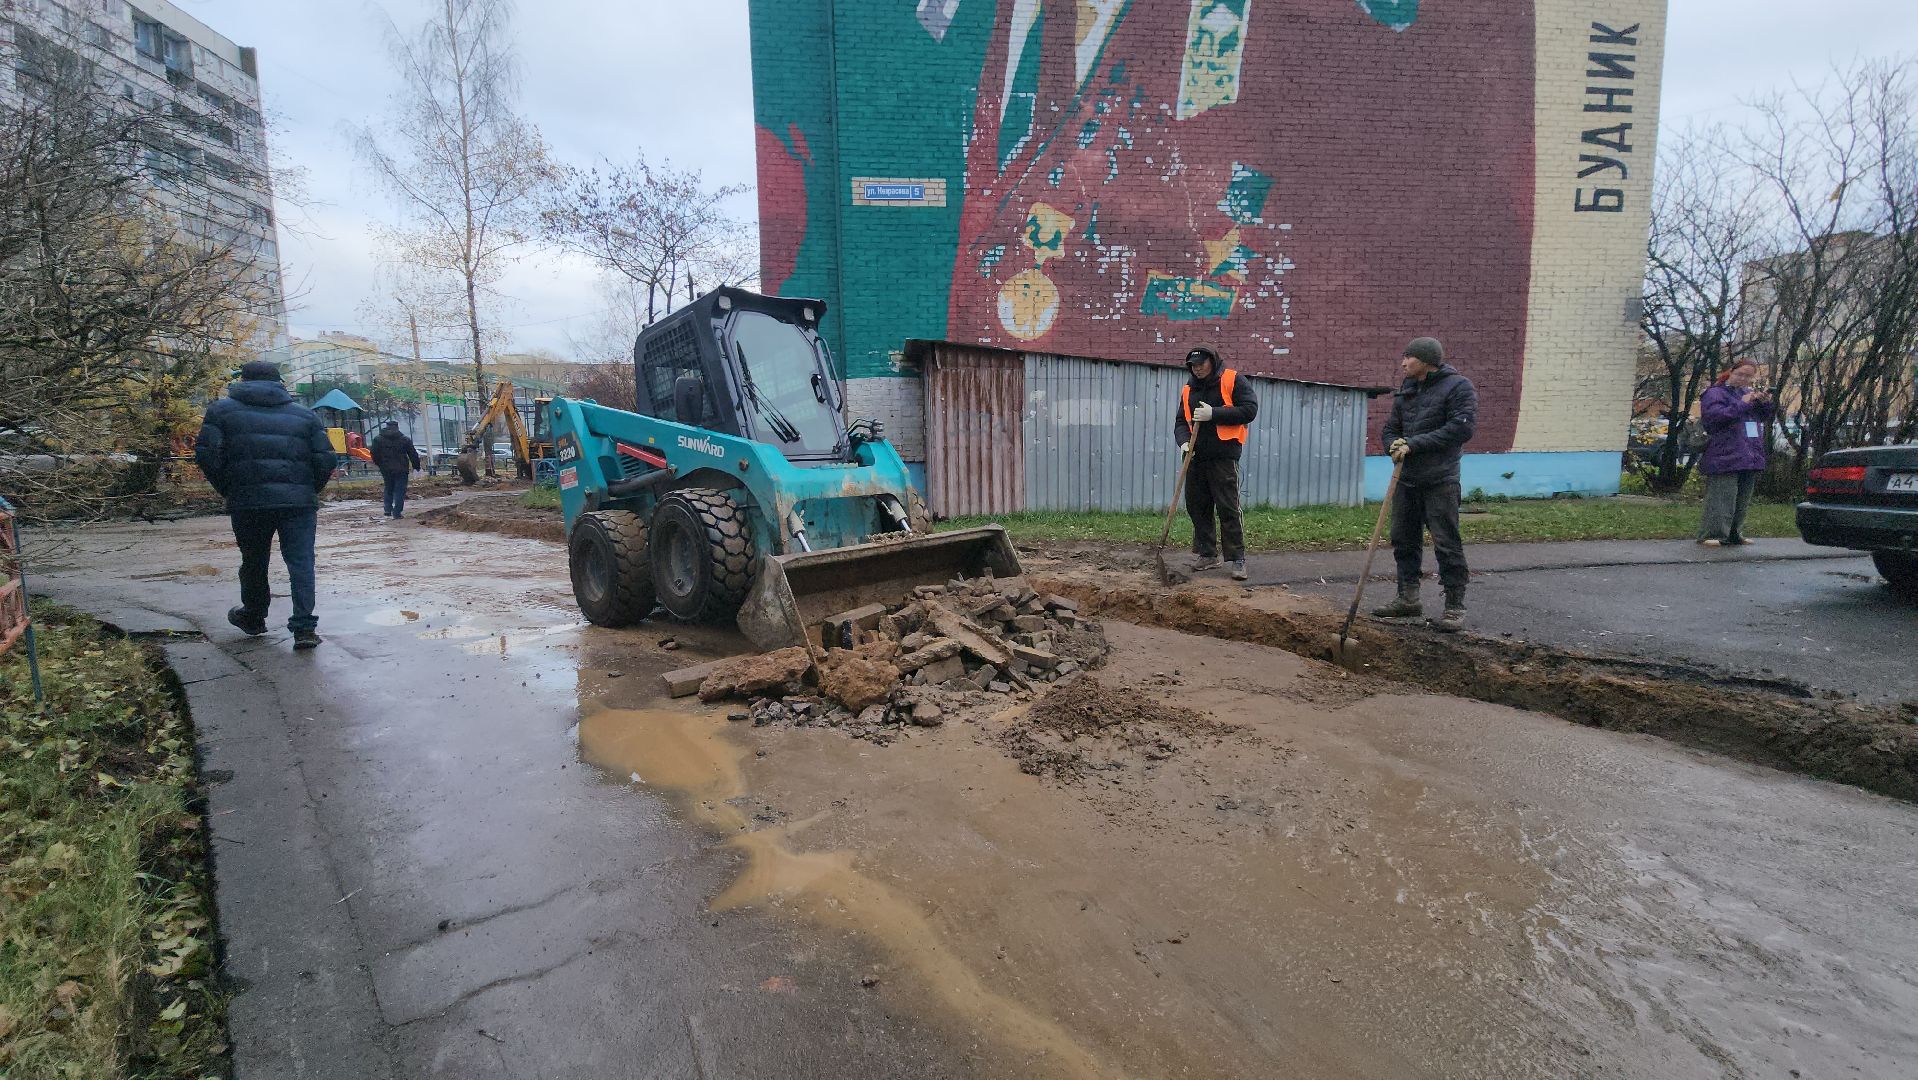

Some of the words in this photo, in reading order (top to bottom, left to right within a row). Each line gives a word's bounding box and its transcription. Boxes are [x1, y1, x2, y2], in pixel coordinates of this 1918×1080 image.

[1574, 21, 1640, 212] БУДНИК
[866, 188, 876, 197] ул.
[914, 187, 920, 196] 5
[677, 435, 725, 458] SUNWARD
